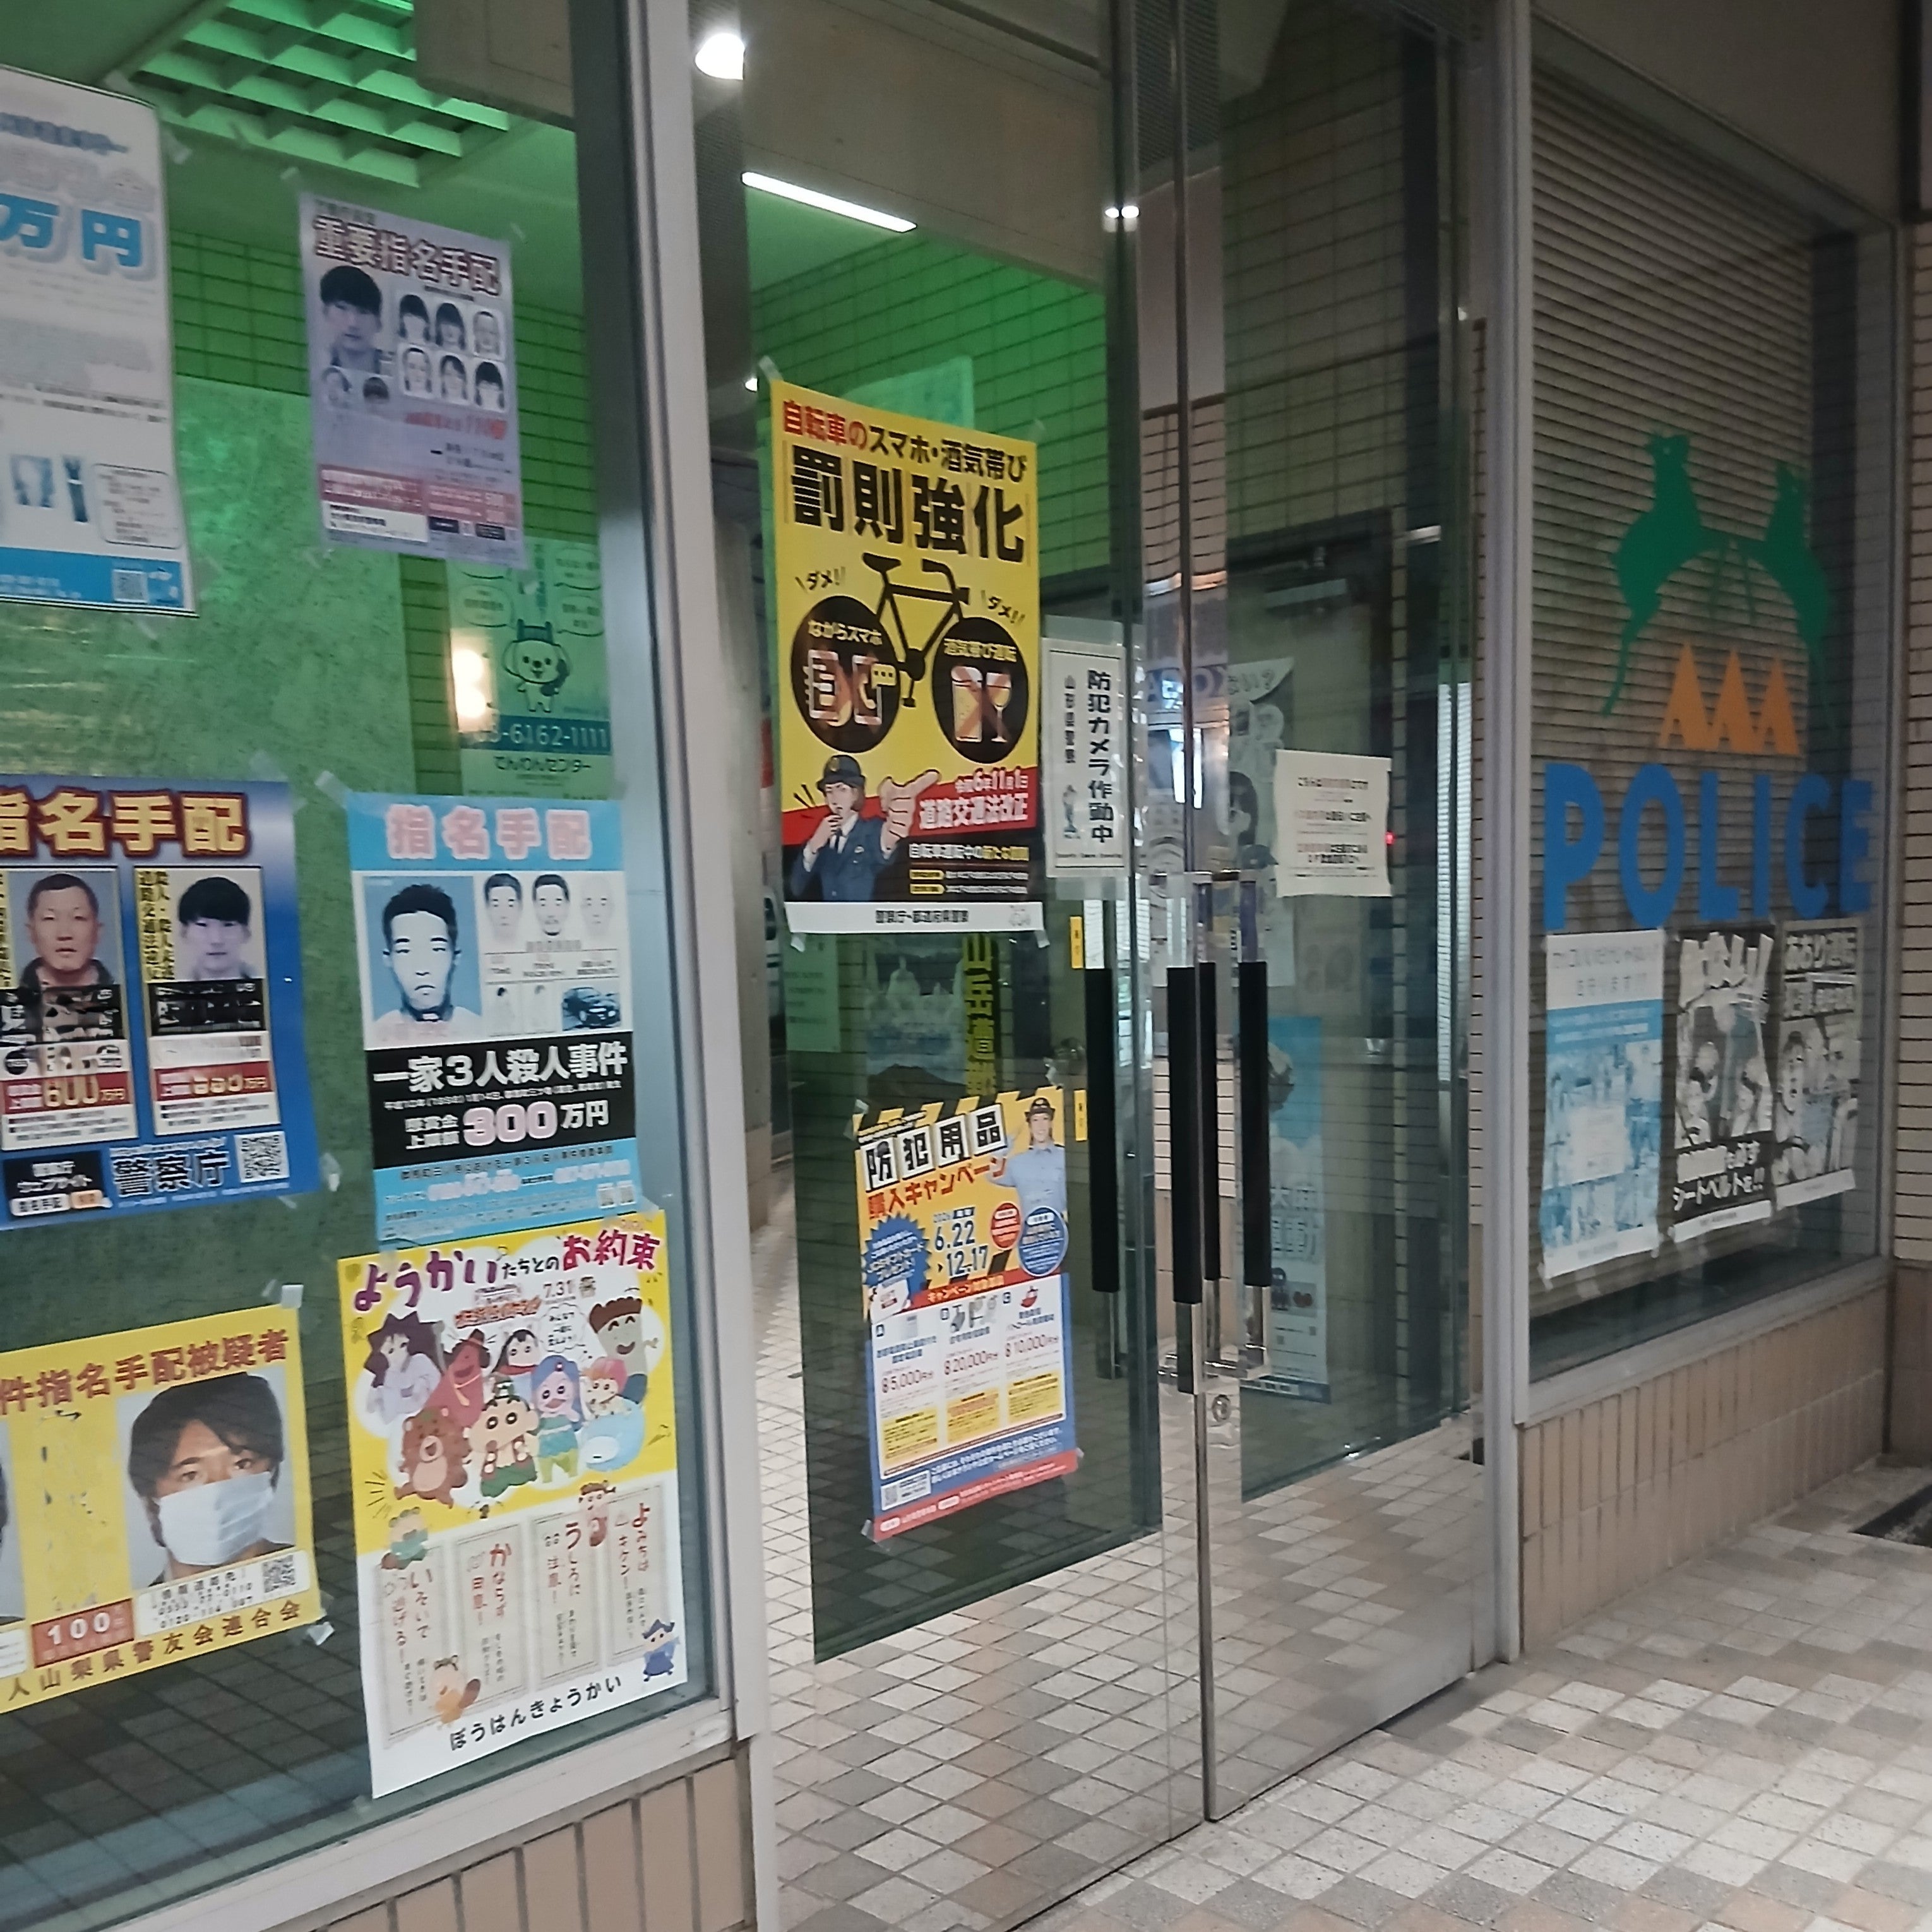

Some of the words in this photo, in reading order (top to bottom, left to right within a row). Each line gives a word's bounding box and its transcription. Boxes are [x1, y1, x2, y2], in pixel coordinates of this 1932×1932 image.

[313, 215, 501, 296] 重要指名手配
[783, 400, 1028, 483] 自転車のスマホ・酒気帯び
[791, 444, 1026, 563] 罰則強化
[1087, 670, 1114, 844] 防犯カメラ作動中
[385, 803, 593, 861] 指名手配
[1543, 763, 1873, 931] POLICE
[373, 1041, 629, 1094] 一家3人殺人事件
[113, 1148, 231, 1198] 警察庁
[866, 1111, 1003, 1191] 防犯用品
[355, 1229, 661, 1312] ようかいたちとのお約束
[934, 1220, 975, 1251] 6.22
[47, 1612, 111, 1645] 100
[449, 1675, 623, 1751] ほうはんきょうかい
